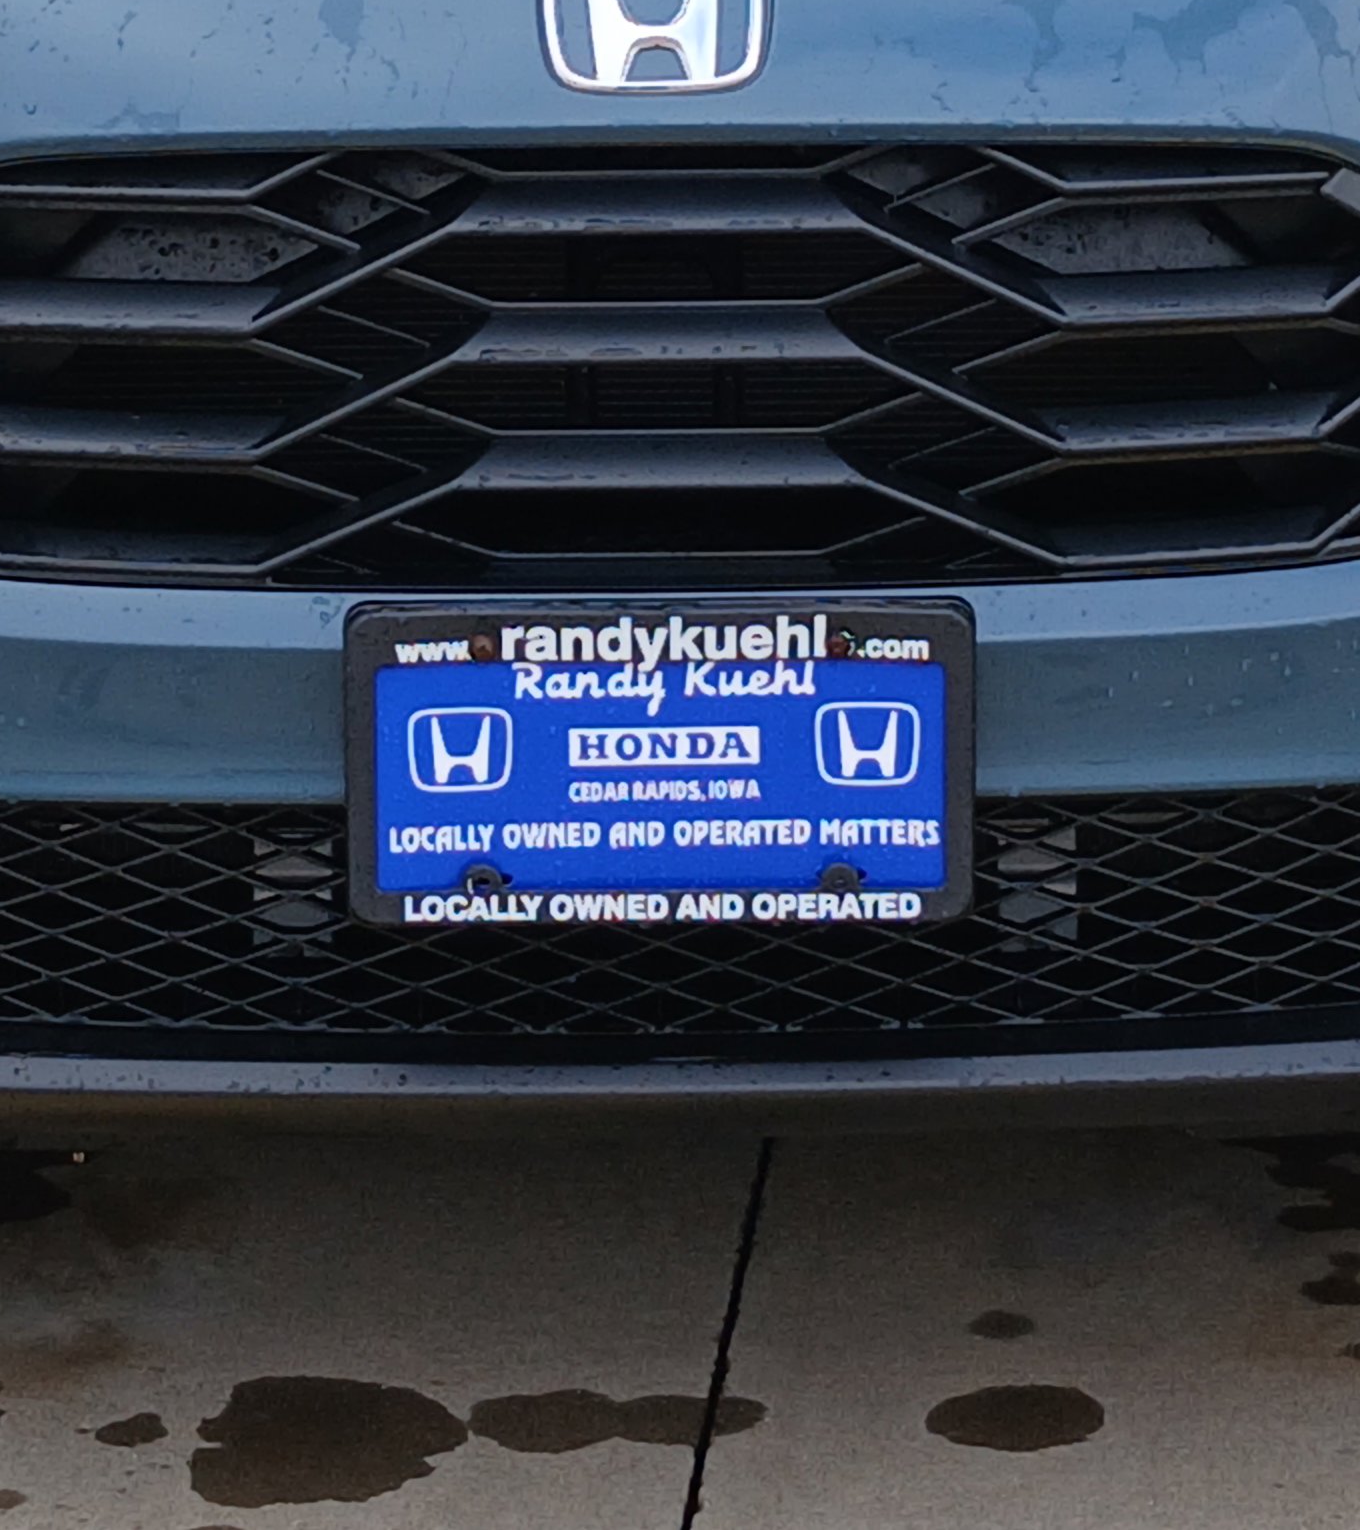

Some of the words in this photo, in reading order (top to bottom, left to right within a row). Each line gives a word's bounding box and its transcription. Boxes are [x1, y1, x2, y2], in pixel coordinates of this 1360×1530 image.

[501, 614, 827, 673] randykuehl
[511, 662, 666, 717] Randy
[684, 660, 816, 696] Kuehl
[577, 732, 751, 761] HONDA
[568, 781, 629, 803] CEDAR
[708, 778, 761, 800] IOWA
[390, 824, 494, 854] LOCALLY
[502, 822, 601, 849] OWNED
[609, 821, 665, 850] AND
[673, 819, 811, 847] OPERATED
[819, 818, 940, 847] MATTERS
[404, 894, 543, 922] LOCALLY
[549, 893, 669, 921] OWNED
[675, 893, 744, 921] AND
[752, 892, 922, 920] OPERATED
